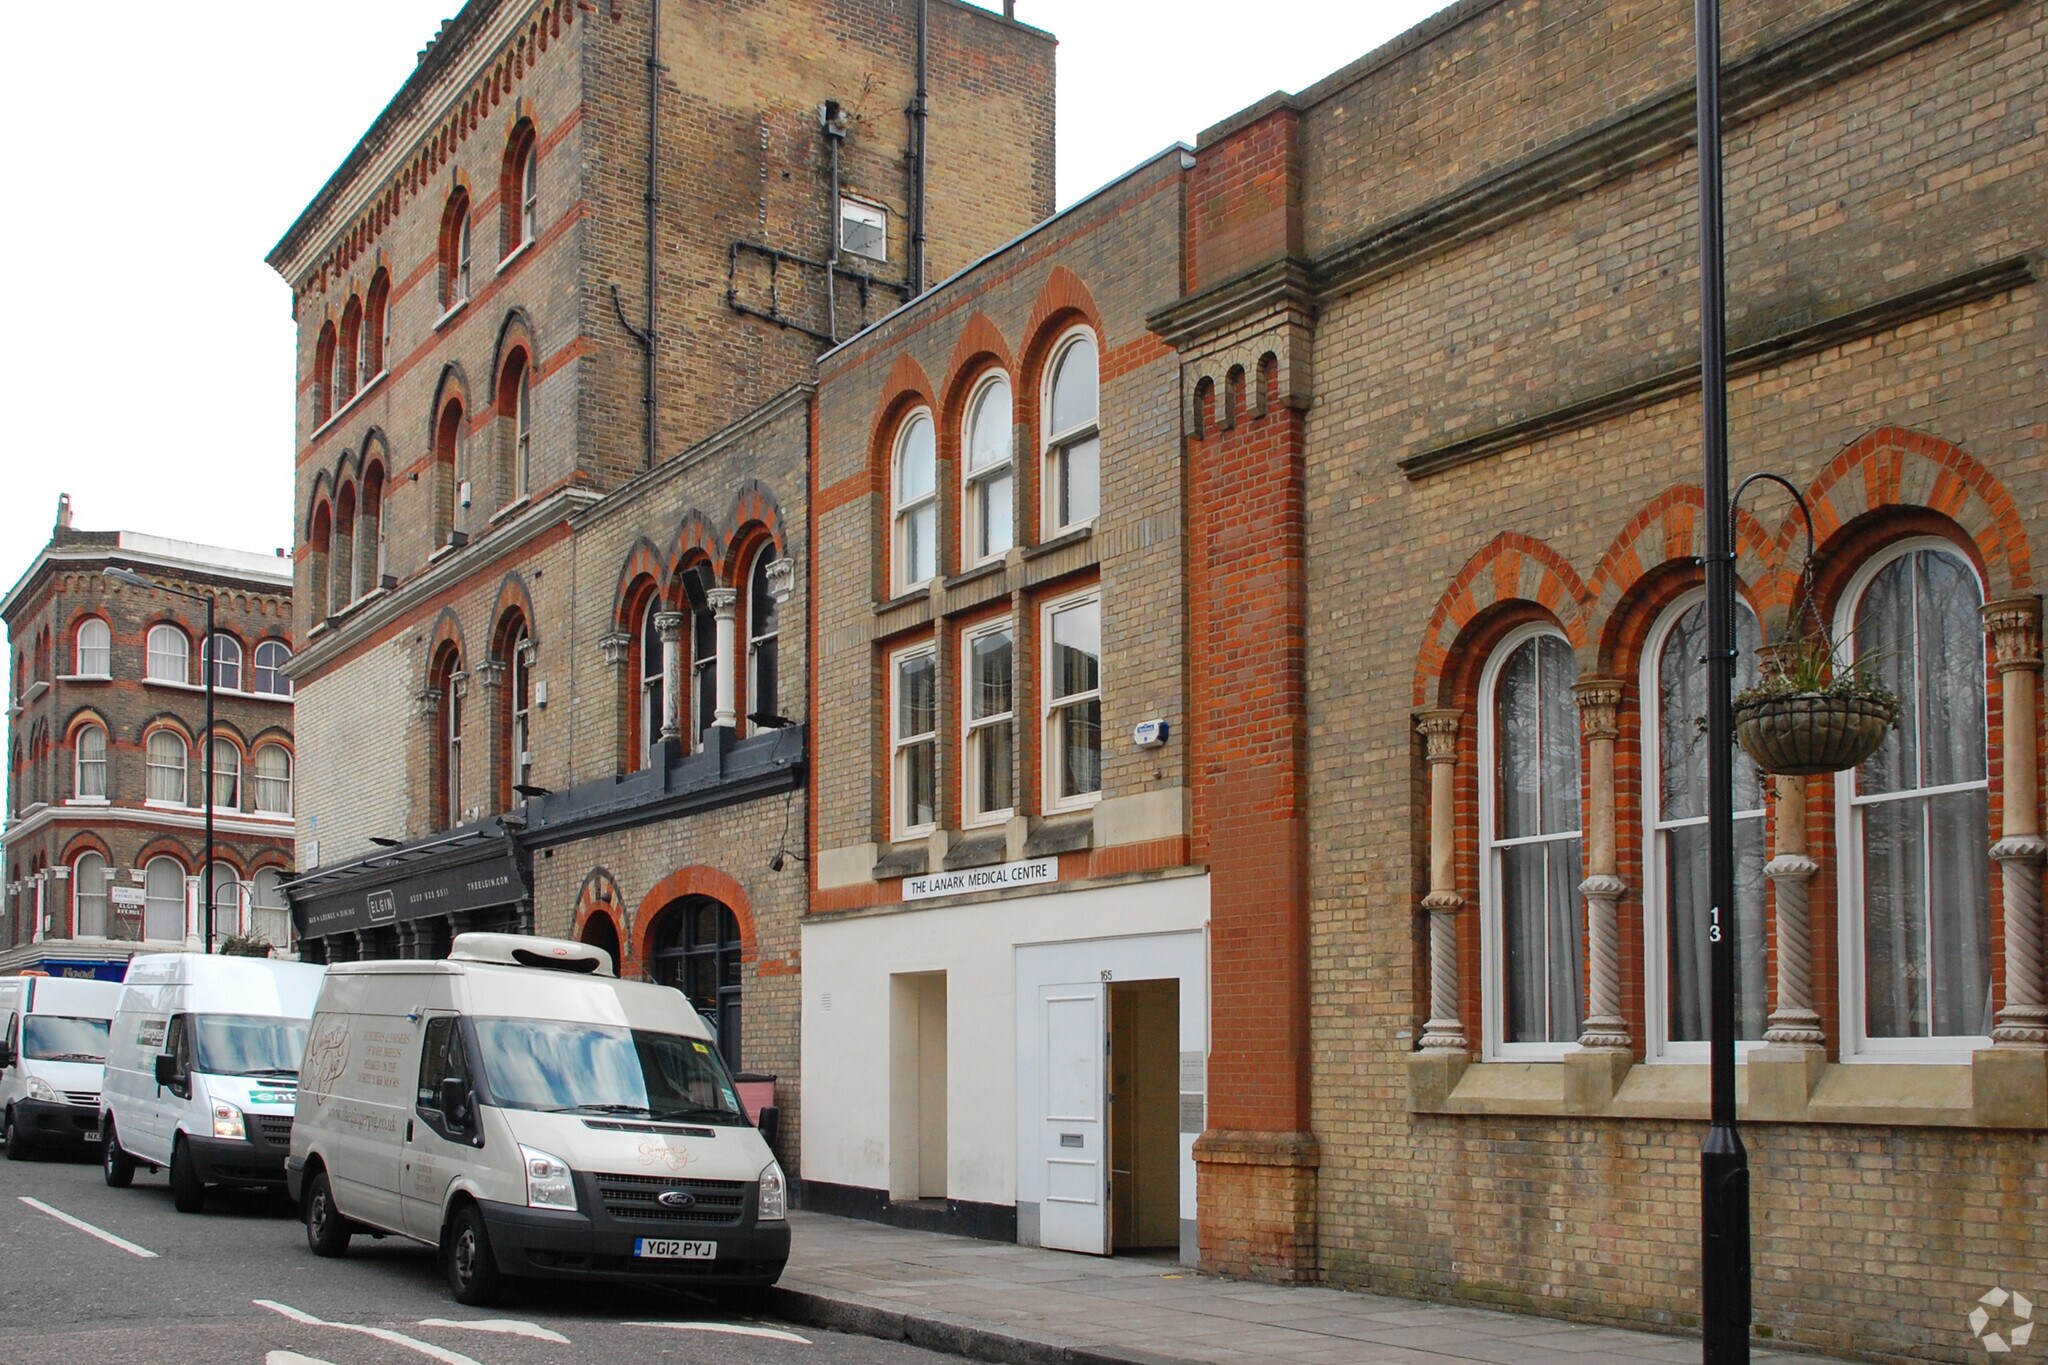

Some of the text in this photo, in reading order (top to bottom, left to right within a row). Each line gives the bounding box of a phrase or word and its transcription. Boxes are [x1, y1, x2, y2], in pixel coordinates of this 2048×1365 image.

[912, 863, 1048, 894] THE LANARK MEDICAL CENTRE
[370, 898, 393, 914] ELGIN
[62, 966, 97, 979] Food
[1100, 969, 1113, 981] 165
[648, 1241, 712, 1256] YG12 PYJ
